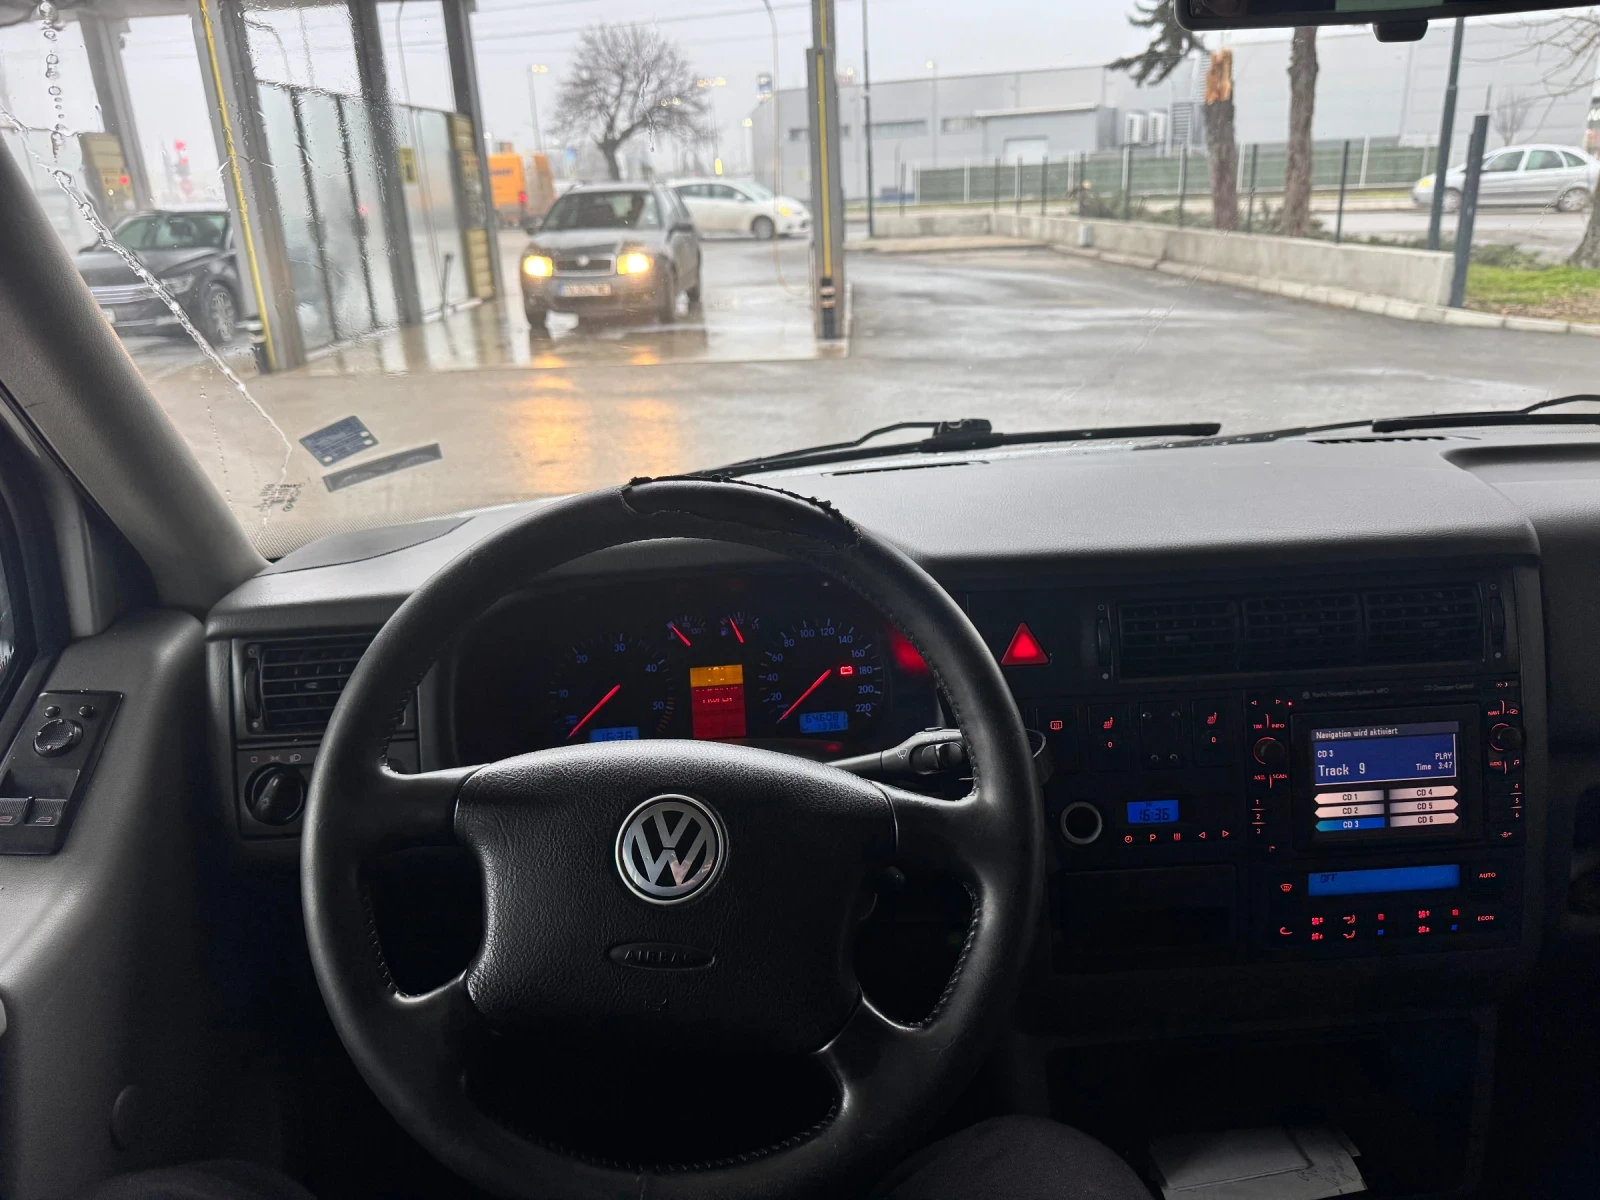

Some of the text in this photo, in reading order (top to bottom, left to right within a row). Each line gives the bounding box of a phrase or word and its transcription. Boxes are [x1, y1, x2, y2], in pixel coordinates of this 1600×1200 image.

[800, 629, 815, 638] 100
[820, 627, 834, 636] 120
[784, 638, 794, 648] 80
[838, 635, 853, 644] 140
[614, 642, 626, 652] 30
[772, 654, 784, 662] 60
[851, 649, 866, 658] 160
[576, 655, 588, 664] 20
[645, 664, 657, 672] 40
[859, 666, 872, 674] 180
[766, 673, 778, 682] 40
[559, 689, 568, 698] 10
[858, 685, 874, 694] 200
[770, 692, 782, 700] 20
[652, 701, 664, 710] 50
[856, 704, 872, 712] 220
[1370, 728, 1398, 736] aktiviert
[1318, 762, 1366, 776] Track 9
[1140, 808, 1170, 822] 16:36
[1320, 873, 1338, 883] OFF
